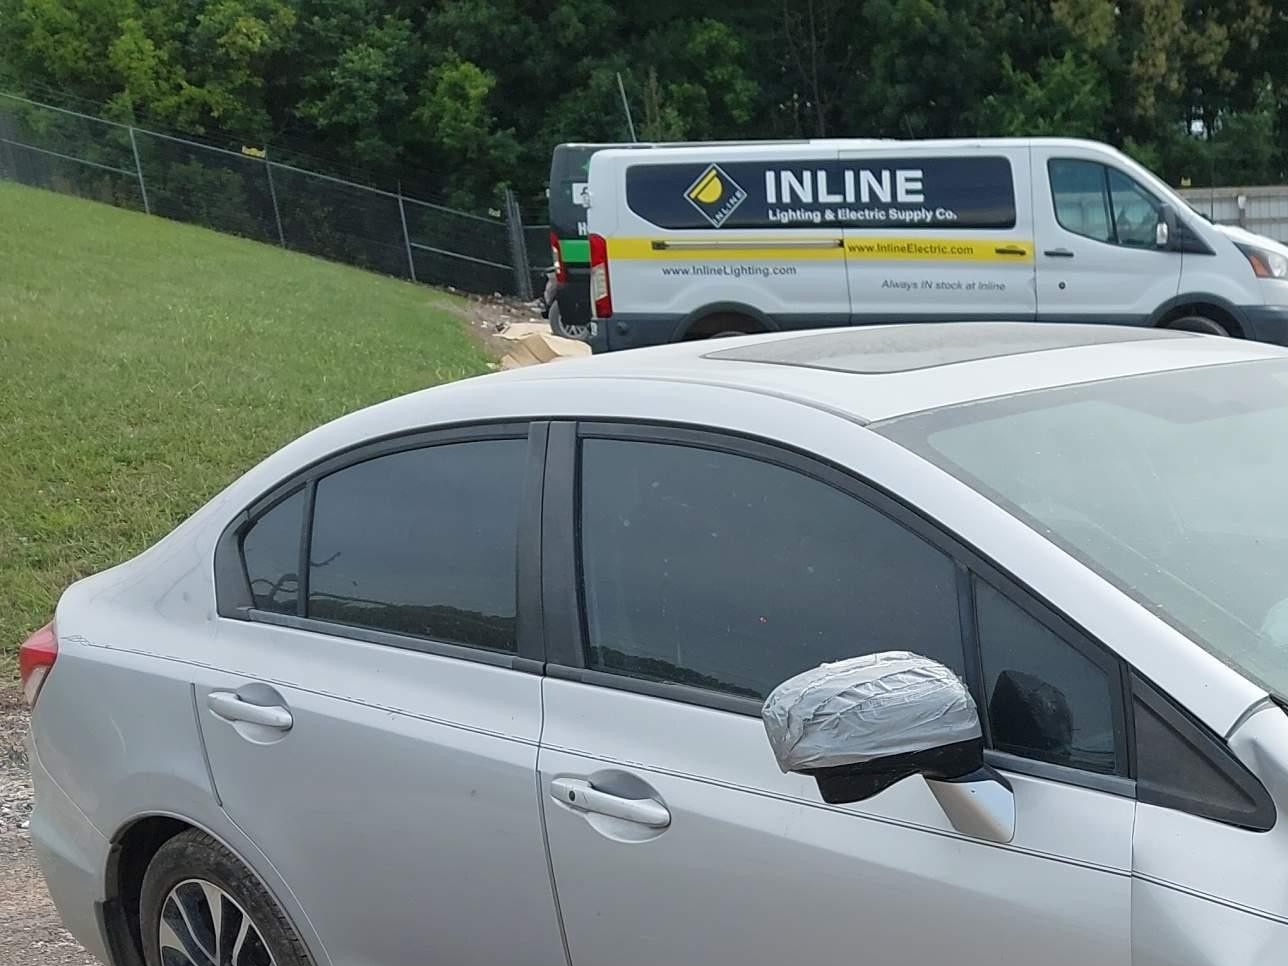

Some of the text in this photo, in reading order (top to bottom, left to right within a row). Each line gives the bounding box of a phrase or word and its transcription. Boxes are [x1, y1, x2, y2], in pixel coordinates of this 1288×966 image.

[765, 169, 925, 204] INLINE
[768, 208, 957, 223] Lighting & Electric Supply Co.
[847, 243, 974, 255] www.InlineElectric.com
[662, 265, 797, 278] www.InlineLighting.com
[881, 279, 1006, 291] Always IN stock at Inline
